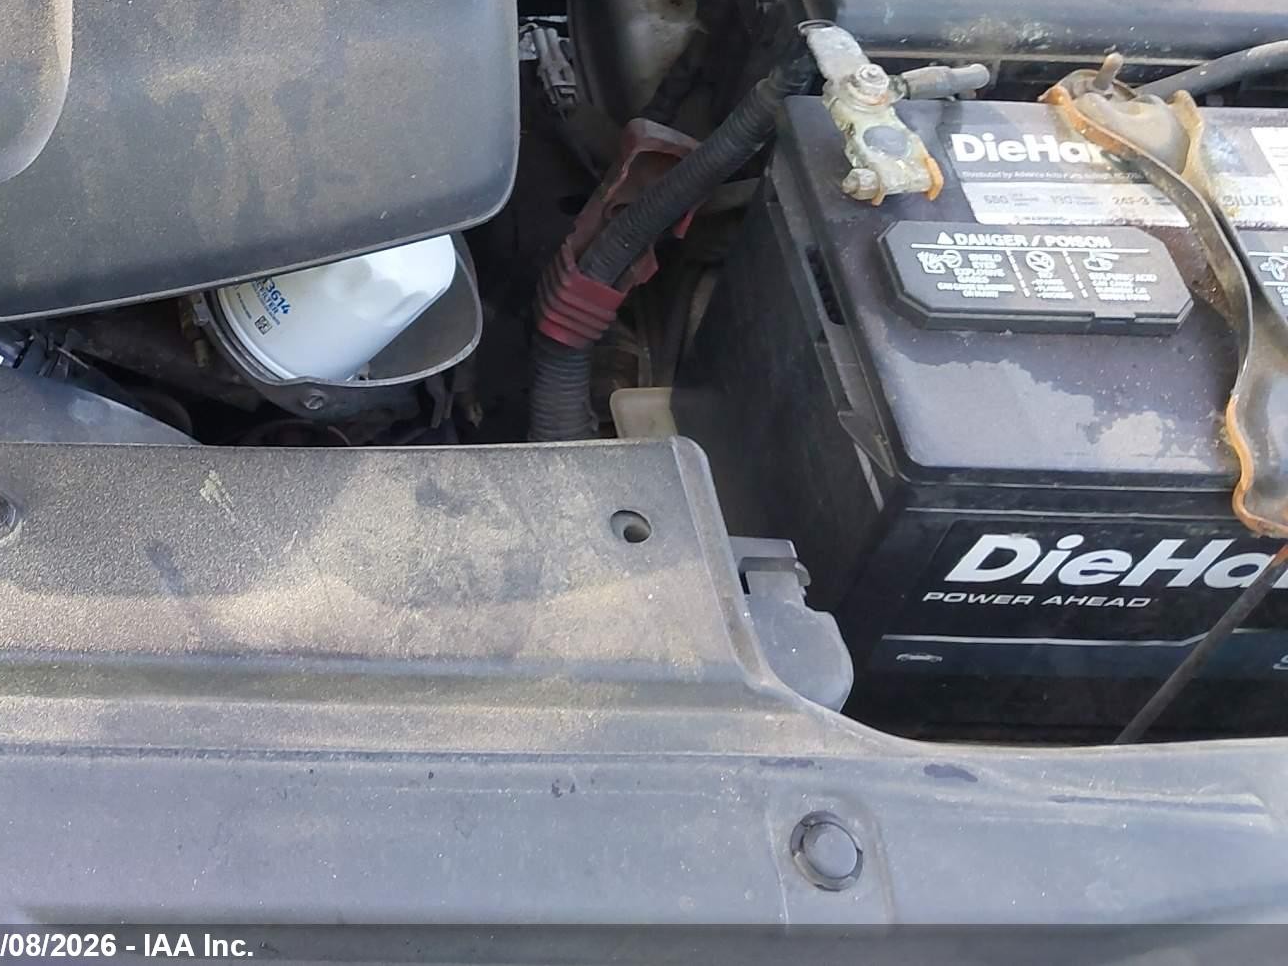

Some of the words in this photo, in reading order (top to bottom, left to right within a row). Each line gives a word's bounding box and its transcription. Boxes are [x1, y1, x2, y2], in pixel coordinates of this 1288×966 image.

[950, 133, 1120, 164] DieHar
[1222, 195, 1282, 208] SILVER
[953, 233, 1029, 247] DANGER
[1043, 235, 1112, 249] POISON
[944, 534, 1288, 588] DieHa
[922, 591, 1035, 606] POWER
[1041, 594, 1151, 608] AHEAD
